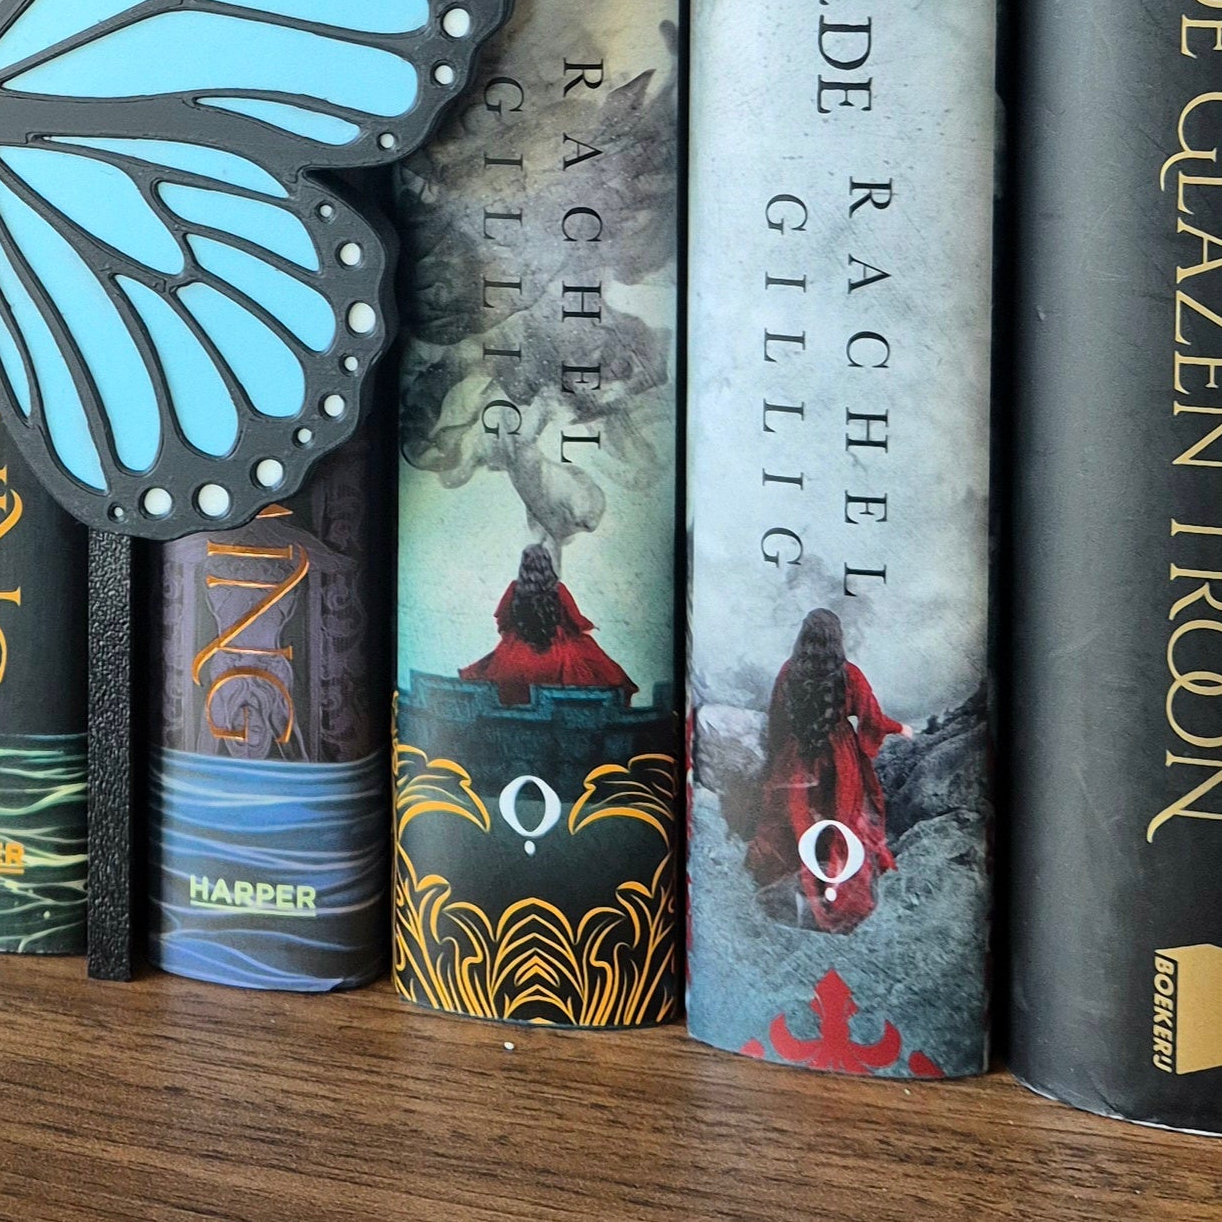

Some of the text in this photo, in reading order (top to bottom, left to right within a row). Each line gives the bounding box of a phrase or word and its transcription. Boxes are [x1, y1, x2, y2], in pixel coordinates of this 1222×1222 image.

[481, 75, 525, 439] GILLIG
[559, 55, 606, 466] RACHEL
[759, 191, 810, 570] GILLIG
[842, 175, 894, 599] RACHEL
[189, 874, 318, 911] HARPER
